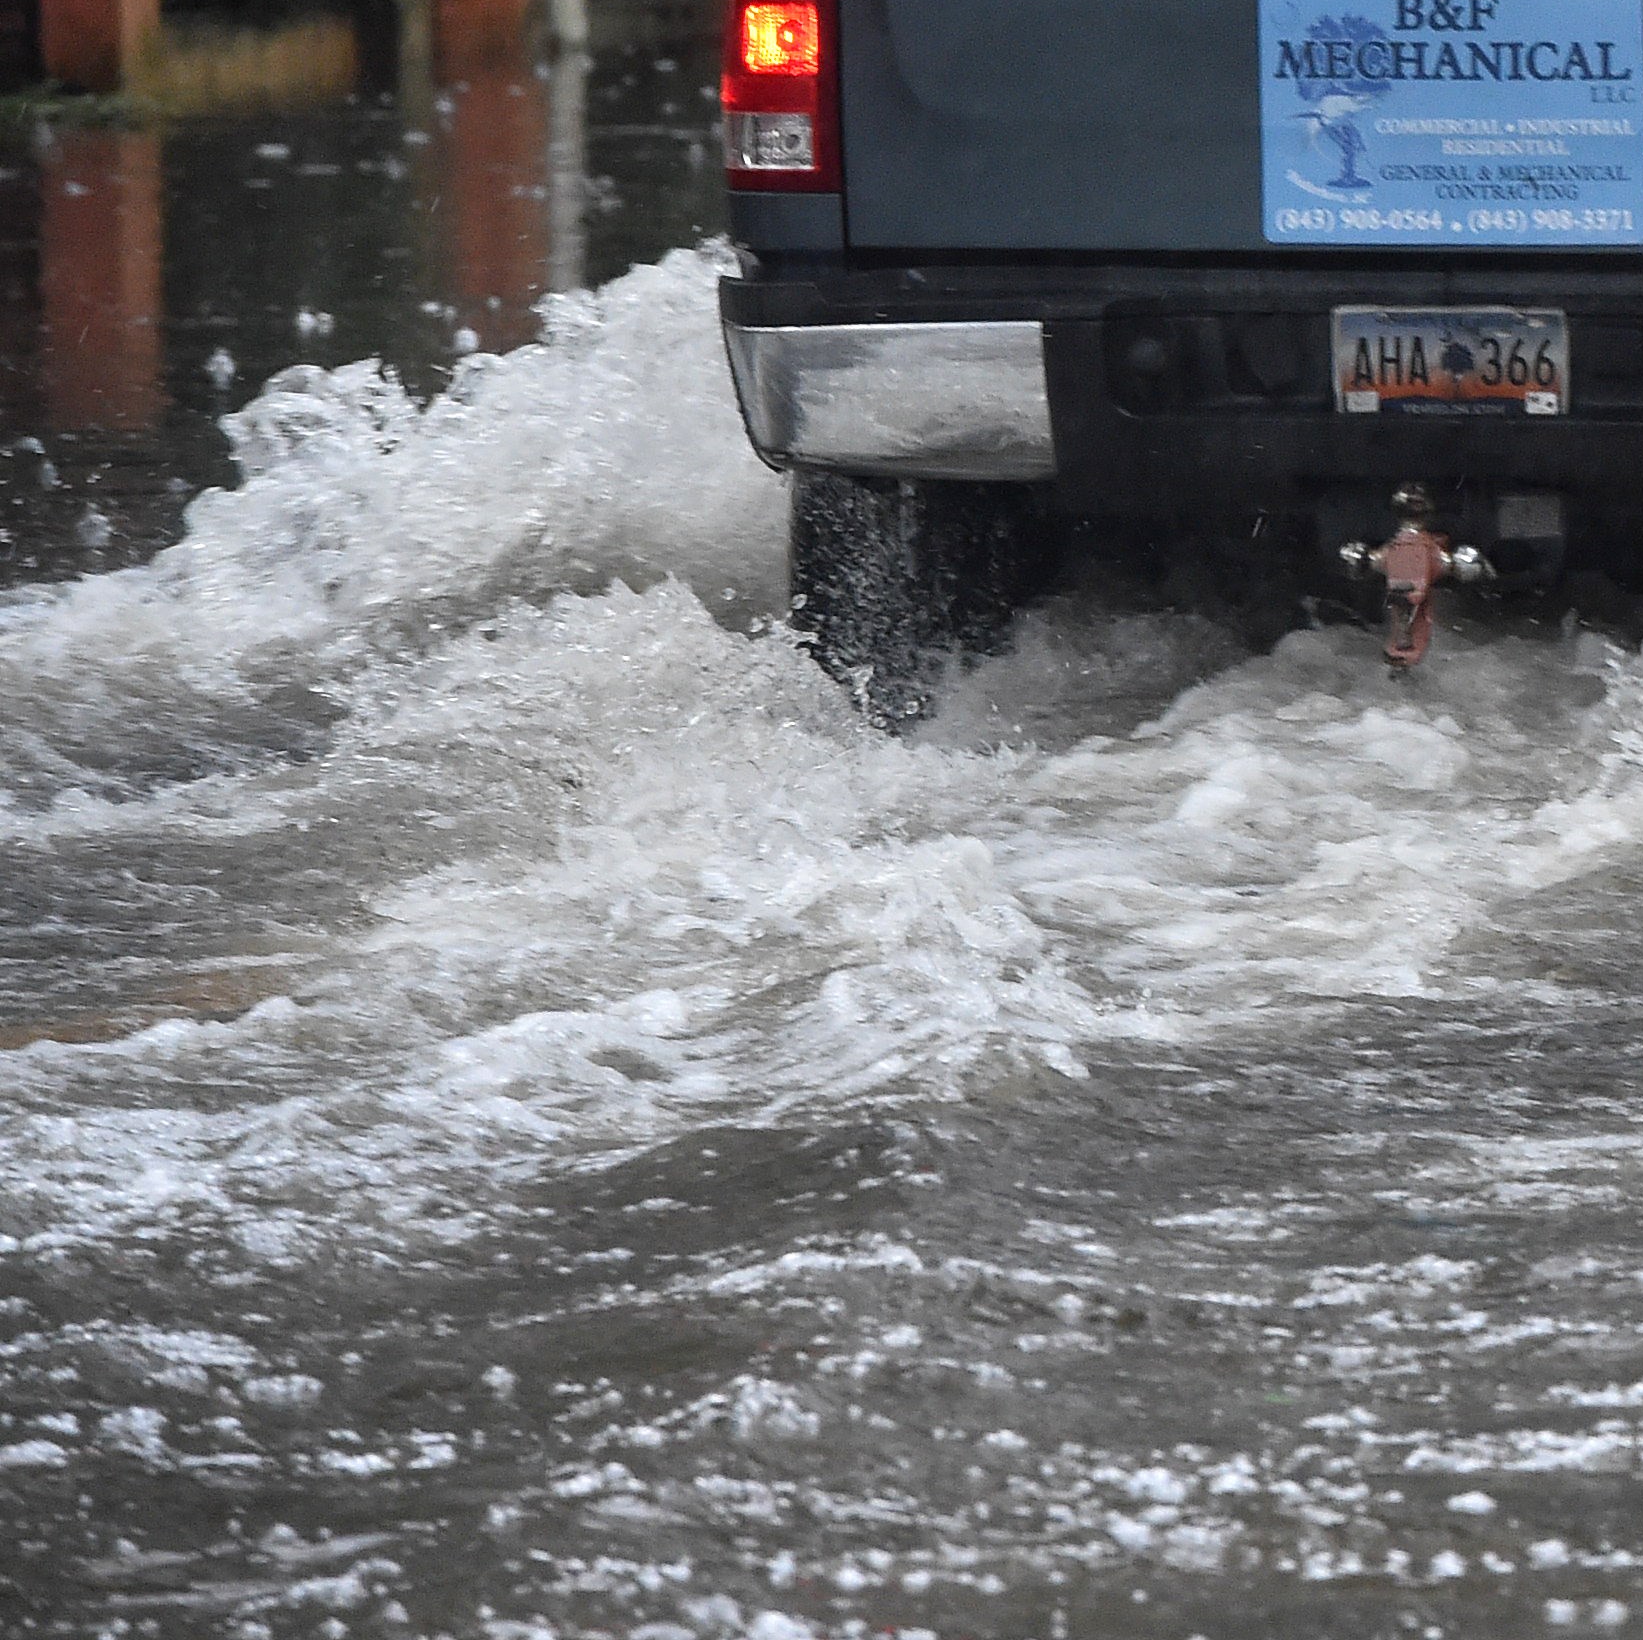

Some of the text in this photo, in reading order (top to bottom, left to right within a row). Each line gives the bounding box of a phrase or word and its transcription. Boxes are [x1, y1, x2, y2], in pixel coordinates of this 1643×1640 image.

[1273, 40, 1633, 81] MECHANICAL
[1590, 86, 1636, 104] LLC
[1374, 118, 1637, 136] COMMERCIAL INDUSTRIAL
[1441, 139, 1570, 156] RESIDENTIAL
[1379, 164, 1632, 182] GENERAL & MECHANICAL
[1434, 183, 1580, 200] CONTRACTING
[1275, 209, 1335, 233] (843)
[1467, 209, 1528, 234] (843)
[1351, 336, 1555, 386] AHA 366
